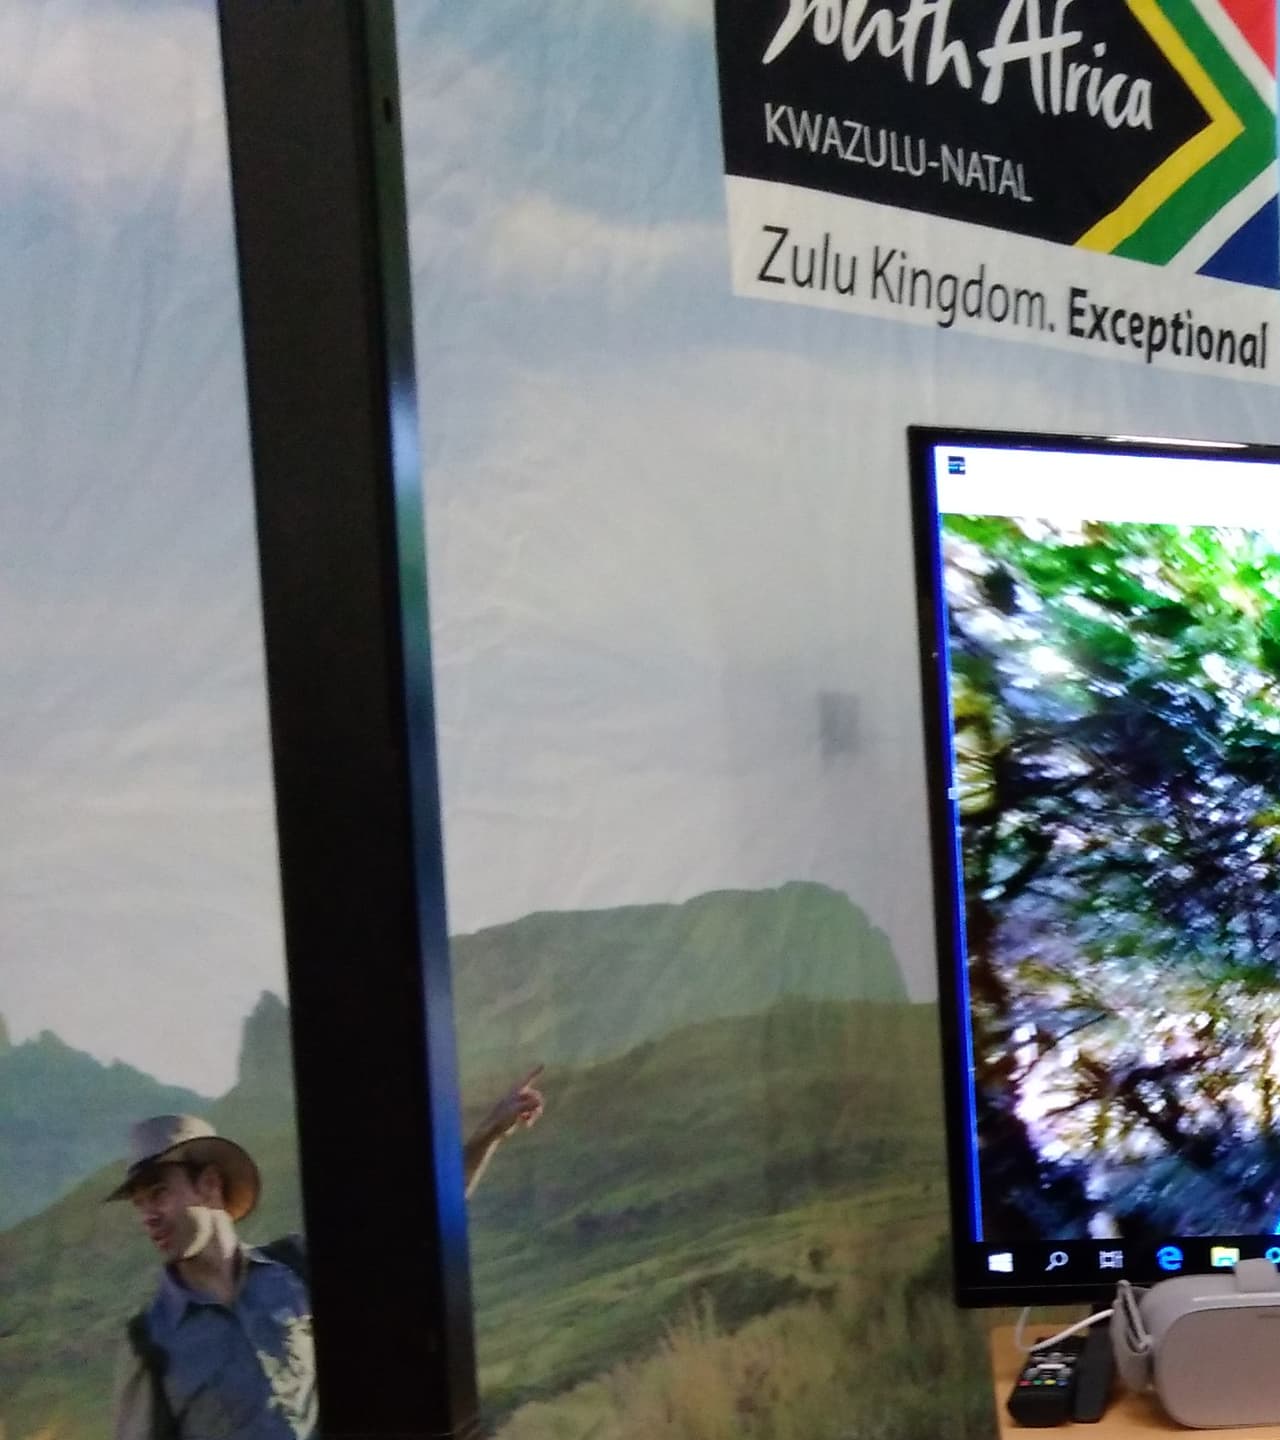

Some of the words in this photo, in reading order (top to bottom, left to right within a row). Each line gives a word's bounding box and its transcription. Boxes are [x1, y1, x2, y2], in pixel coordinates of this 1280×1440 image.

[763, 102, 1034, 202] KWAZULU-NATAL
[757, 225, 857, 296] Zulu
[871, 245, 1057, 332] Kingdom.
[1068, 287, 1268, 369] Exceptional
